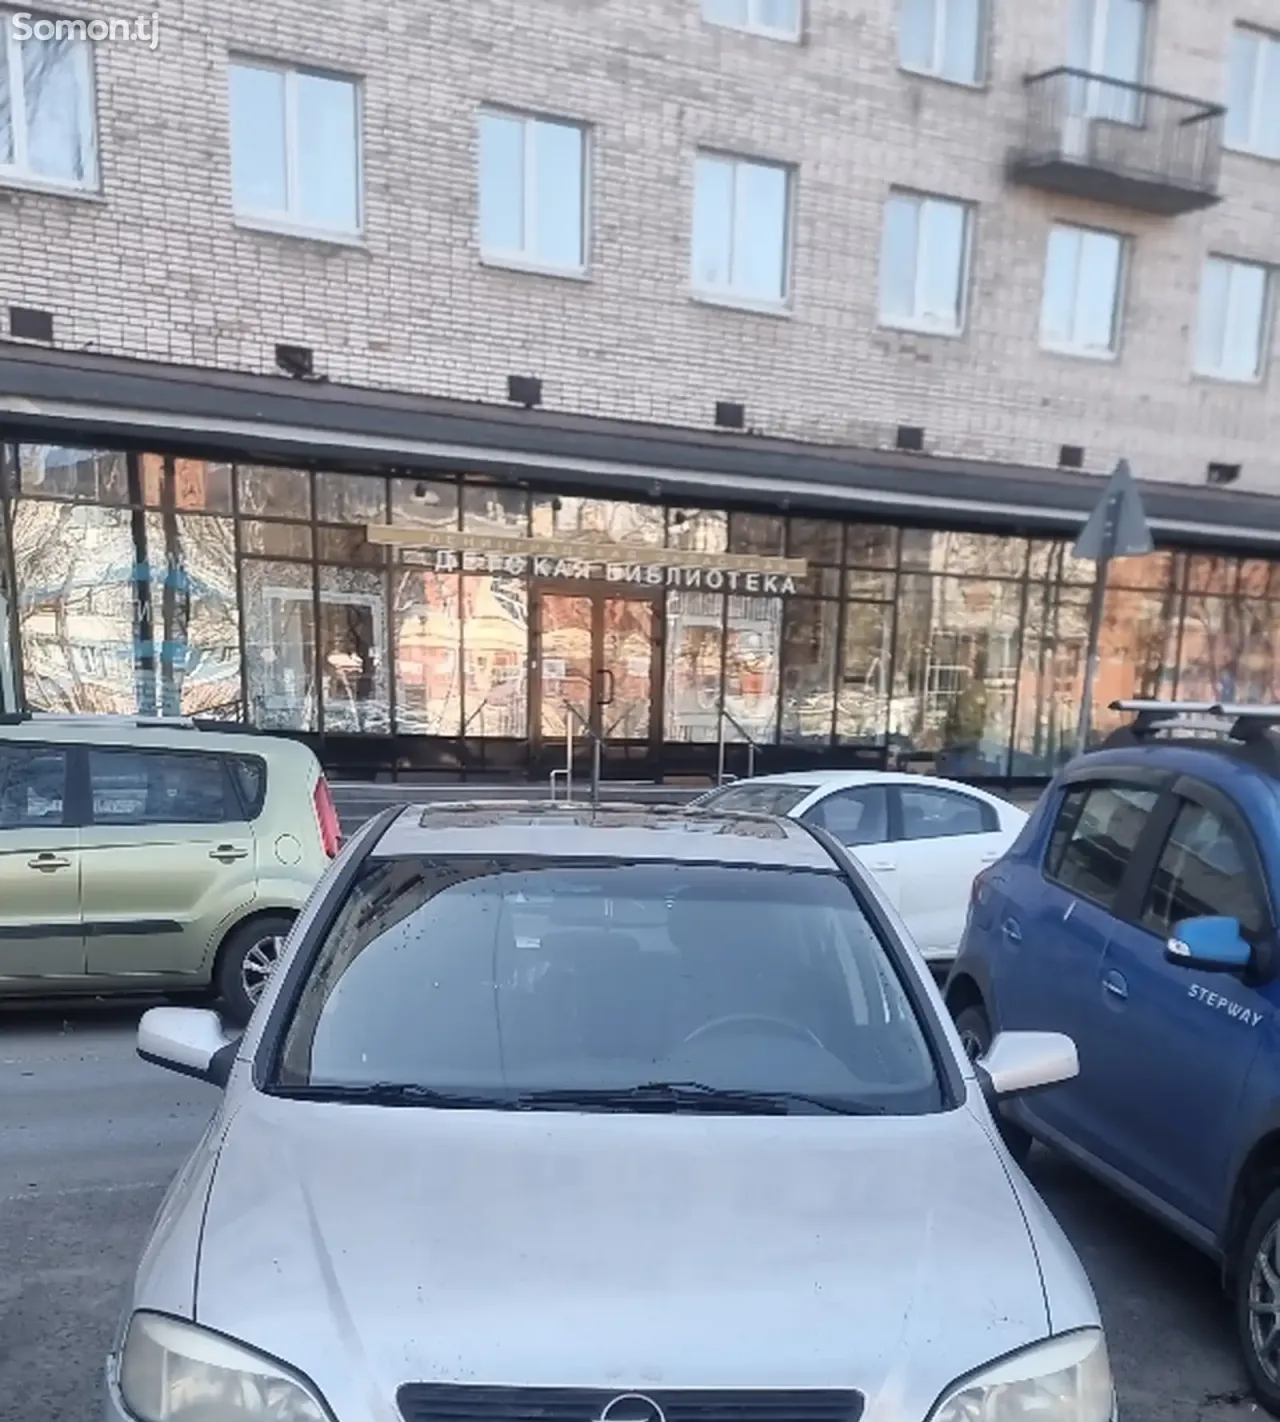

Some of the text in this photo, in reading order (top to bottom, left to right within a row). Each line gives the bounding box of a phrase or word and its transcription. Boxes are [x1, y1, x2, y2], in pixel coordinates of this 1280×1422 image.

[434, 550, 797, 594] ДЕТСКАЯ БИБЛИОТЕКА
[1187, 983, 1264, 1027] STEPWAY
